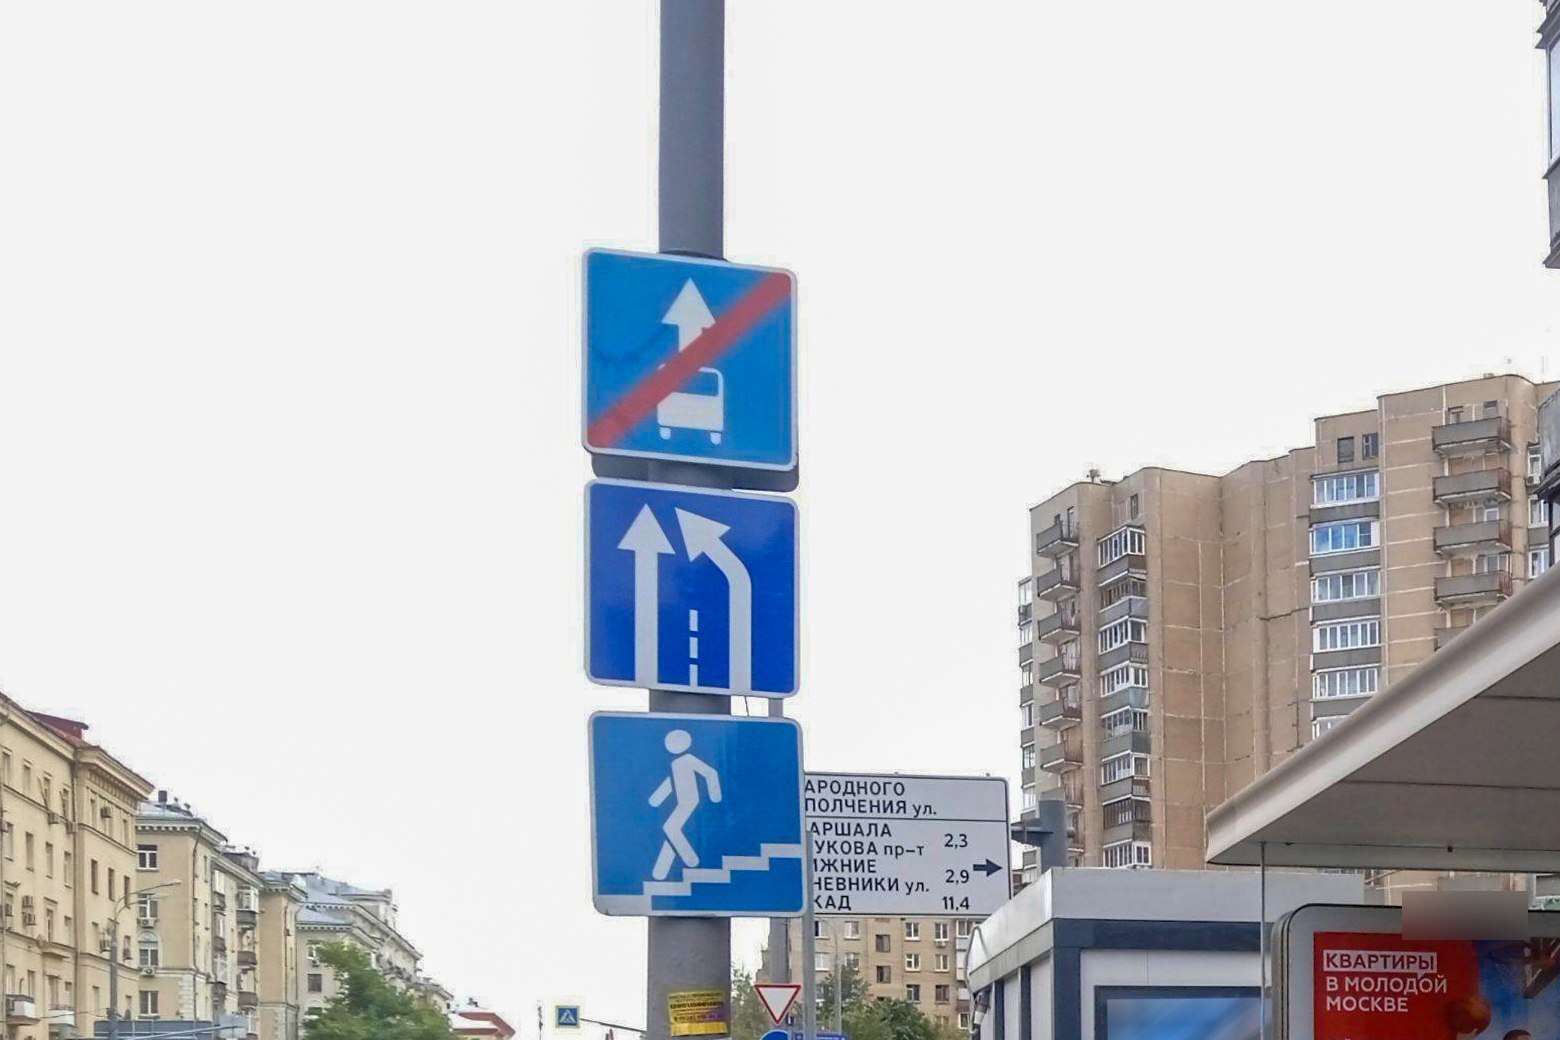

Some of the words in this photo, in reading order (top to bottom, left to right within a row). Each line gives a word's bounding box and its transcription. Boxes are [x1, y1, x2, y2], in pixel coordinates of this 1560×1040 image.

[805, 779, 905, 797] АРОДНОГО
[805, 798, 907, 814] ПОЛЧЕНИЯ
[912, 804, 937, 818] ул.
[810, 822, 892, 838] АРШАЛА
[814, 840, 879, 855] УКОВА
[944, 833, 968, 849] 2,3
[945, 869, 970, 885] 2,9
[814, 877, 899, 892] НЕВНИКИ
[905, 881, 930, 896] ул.
[942, 896, 970, 911] 11,4
[1326, 952, 1434, 970] КВАРТИРЫ
[1326, 976, 1339, 992] В
[1344, 974, 1448, 996] МОЛОДОЙ
[1326, 996, 1409, 1012] МОСКВЕ
